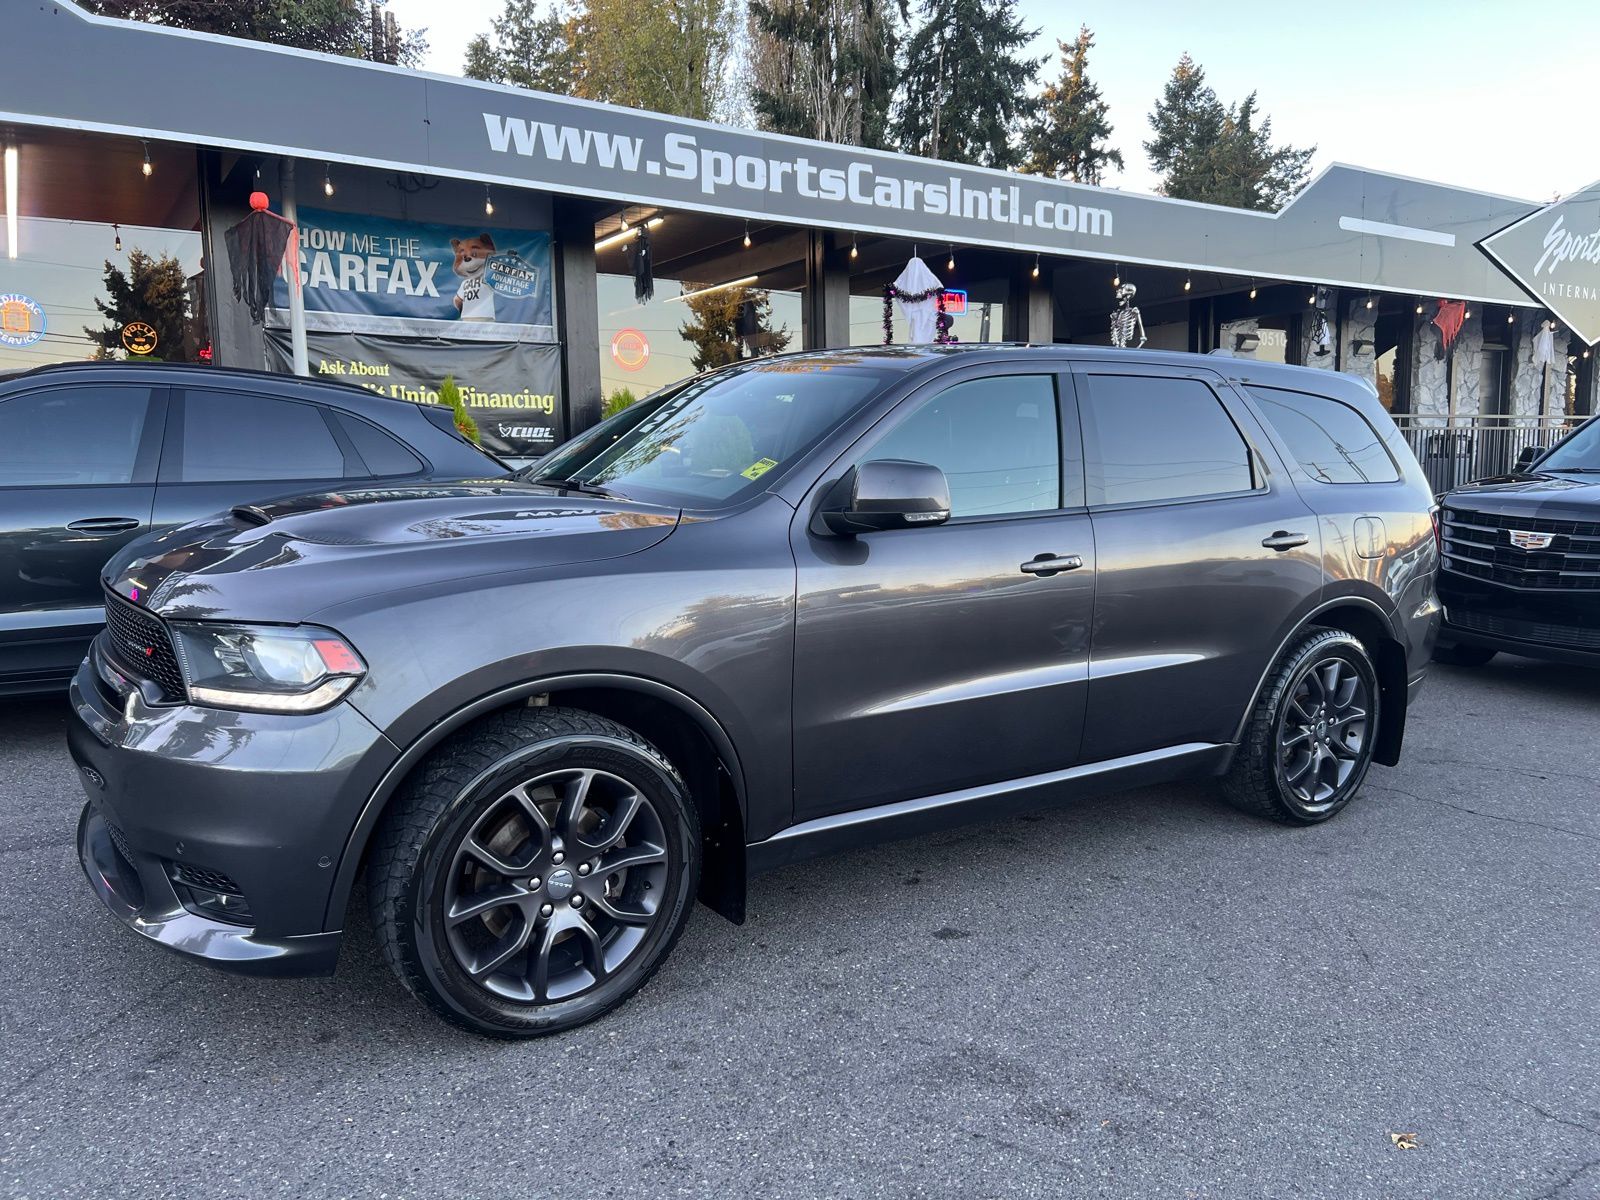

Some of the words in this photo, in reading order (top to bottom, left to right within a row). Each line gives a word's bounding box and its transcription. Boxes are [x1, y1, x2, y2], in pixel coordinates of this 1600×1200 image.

[482, 112, 1113, 237] www.SportsCarsIntl.com
[298, 228, 347, 251] HOW
[352, 233, 381, 255] ME
[385, 237, 421, 259] THE
[490, 262, 534, 281] CARFAX
[491, 273, 529, 289] ADVANTAGE
[494, 282, 522, 295] DEALER
[1543, 282, 1600, 300] INTERNA
[0, 295, 41, 315] DILLAC
[1258, 331, 1286, 346] 0510
[318, 360, 346, 375] Ask
[349, 361, 389, 377] About
[390, 384, 441, 404] Unio
[458, 387, 554, 415] Financing
